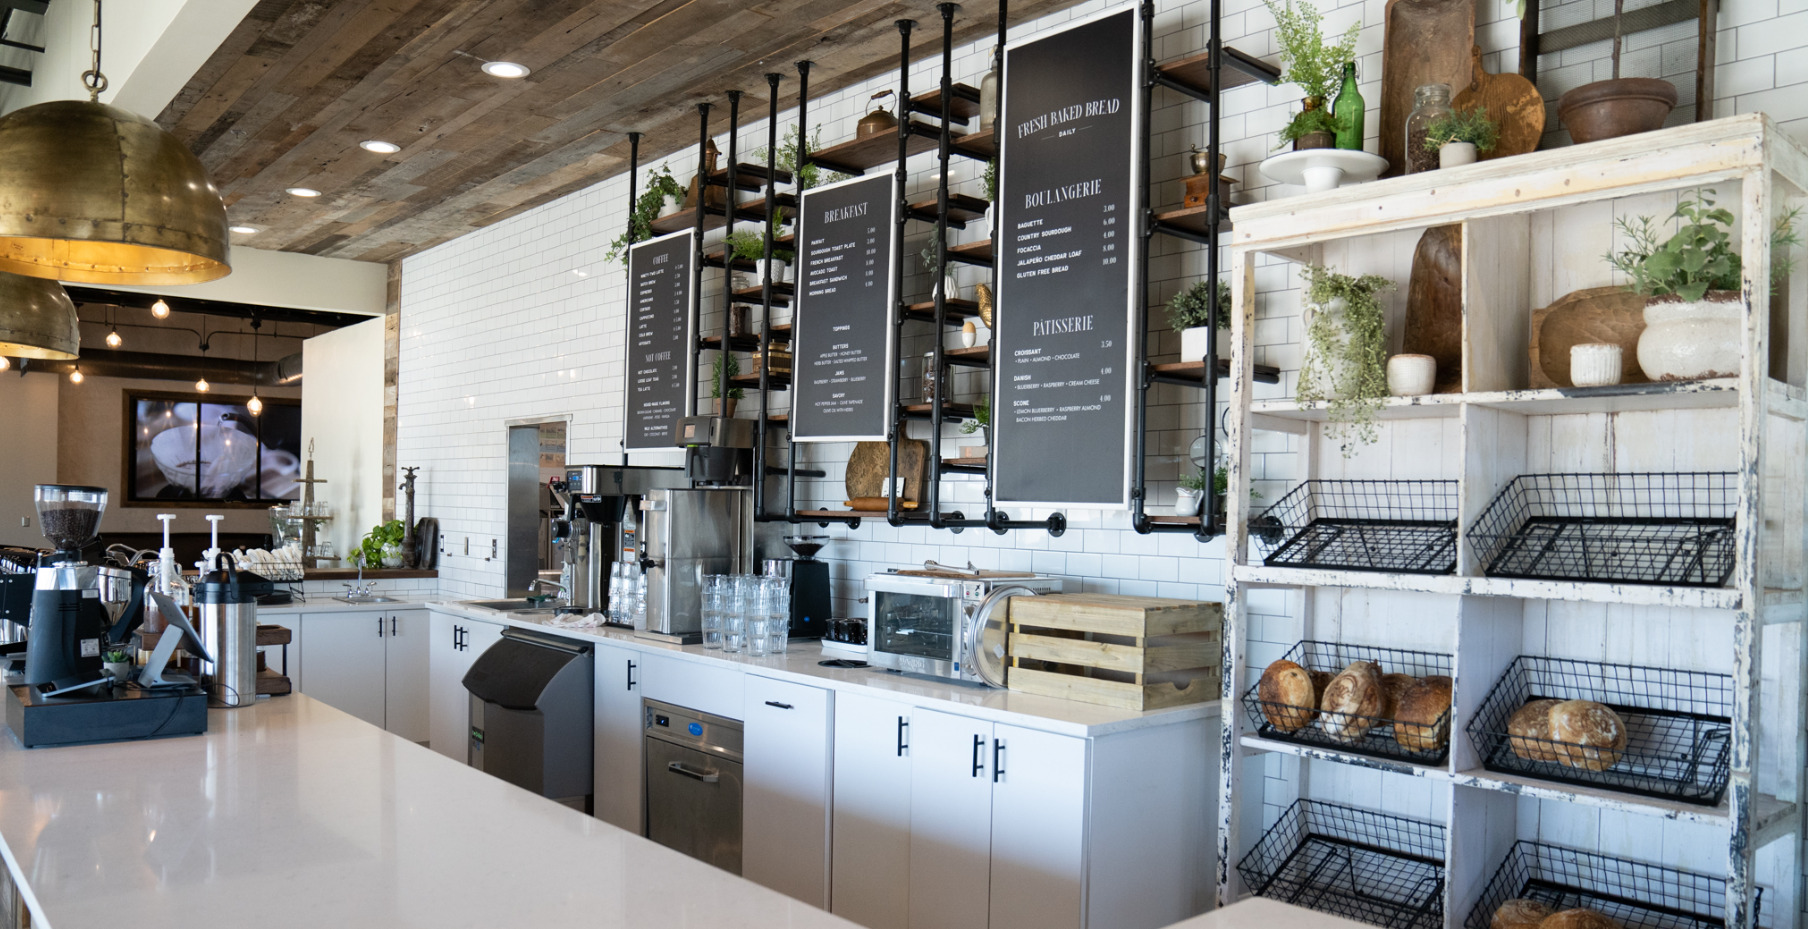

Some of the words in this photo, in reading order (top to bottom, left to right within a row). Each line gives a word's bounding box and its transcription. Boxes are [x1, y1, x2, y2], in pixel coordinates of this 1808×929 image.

[1017, 114, 1048, 139] FRESH
[1050, 104, 1082, 126] BAKED
[1085, 98, 1120, 116] BREAD
[1058, 128, 1077, 138] DAILY
[1025, 179, 1102, 209] BOULANGERIE
[825, 202, 868, 223] BREAKFAST
[1017, 219, 1044, 229] BAGUETTE
[1017, 232, 1040, 242] COUNTRY
[1042, 226, 1072, 237] SOURDOUGH
[1017, 245, 1041, 254] FOCACCIA
[1017, 256, 1042, 266] JALAPEÑO
[1044, 253, 1067, 262] CHEDDAR
[1068, 250, 1082, 258] LOAF
[1017, 269, 1036, 279] GLUTEN
[1037, 267, 1050, 275] FREE
[1052, 265, 1068, 273] BREAD
[1102, 257, 1116, 266] 10.00
[655, 351, 671, 361] COFFEE
[1014, 348, 1042, 356] CROISSANT
[1101, 340, 1112, 348] 3.50
[1101, 367, 1112, 375] 4.00
